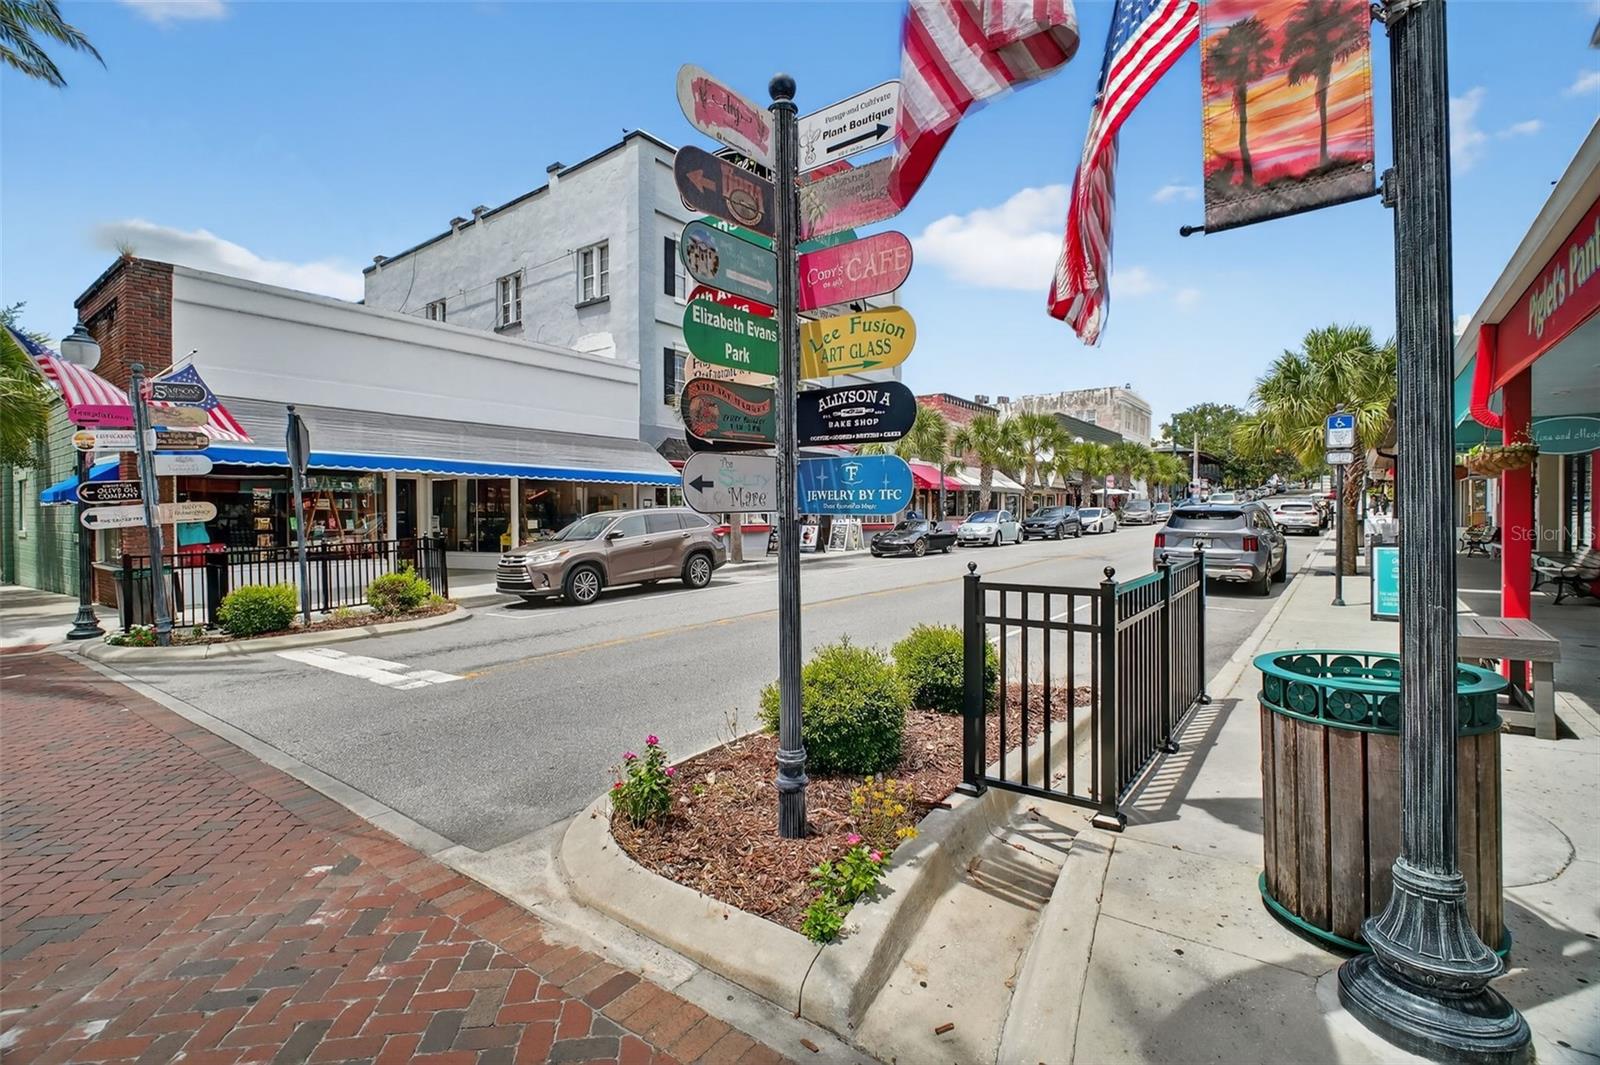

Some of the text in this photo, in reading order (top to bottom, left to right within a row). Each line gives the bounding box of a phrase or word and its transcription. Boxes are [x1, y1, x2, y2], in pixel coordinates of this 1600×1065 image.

[822, 107, 894, 140] Plant Boutique
[847, 245, 908, 282] CAFE
[1528, 262, 1566, 340] Piglet's
[692, 304, 745, 335] Elizabeth
[747, 319, 778, 342] Evans
[809, 316, 906, 353] Lee Fusion
[724, 342, 750, 364] Park
[821, 338, 893, 364] ART GLASS
[818, 390, 891, 412] ALLYSON A
[828, 418, 879, 428] BAKE SHOP
[1554, 428, 1571, 440] and
[719, 456, 733, 469] The
[727, 487, 767, 508] Mare
[807, 489, 903, 502] JEWELRY BY TFC
